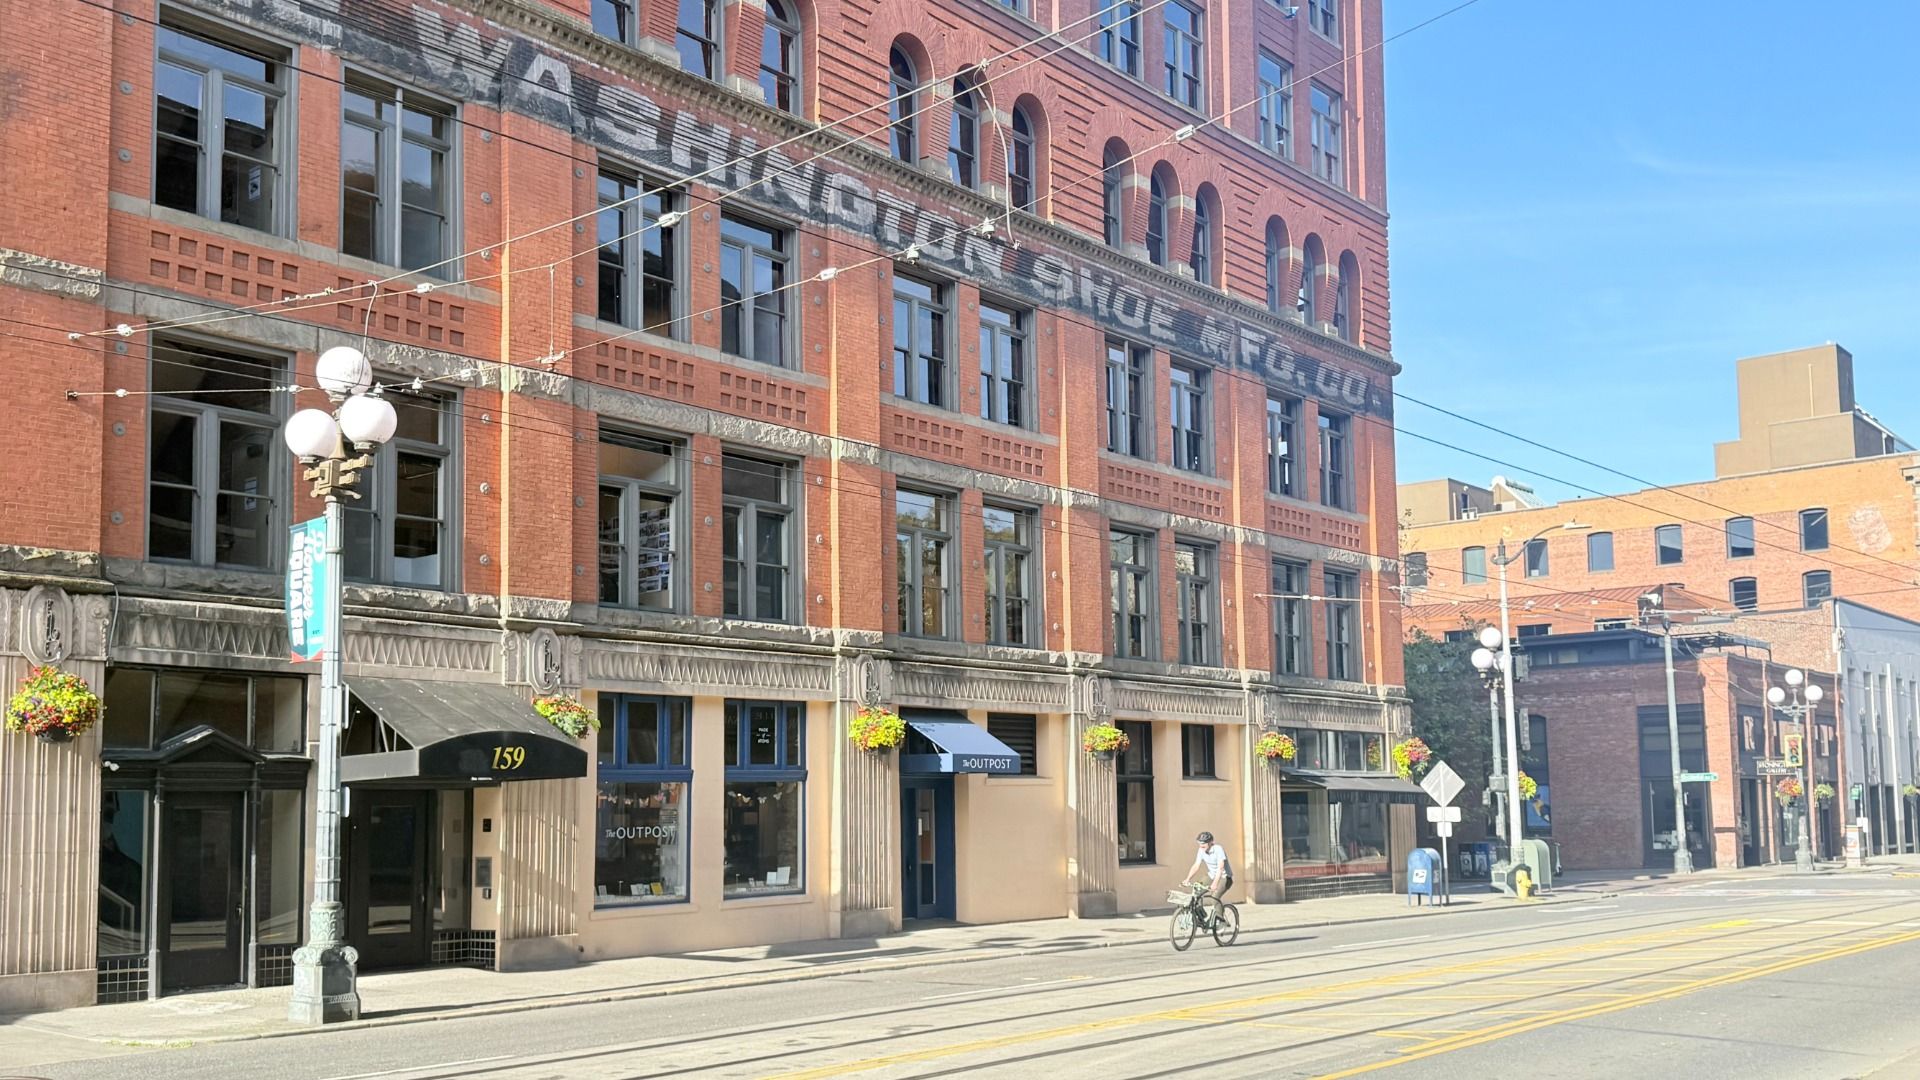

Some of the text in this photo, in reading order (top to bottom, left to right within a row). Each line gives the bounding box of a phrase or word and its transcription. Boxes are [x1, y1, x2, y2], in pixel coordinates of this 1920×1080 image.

[412, 4, 1001, 277] WASHINGTON
[1031, 251, 1182, 342] SHOE
[289, 531, 304, 646] SQUARE
[303, 529, 325, 620] Pioneer
[492, 746, 526, 769] 159
[969, 758, 1011, 769] OUTPOST
[605, 825, 676, 839] The OUTPOST
